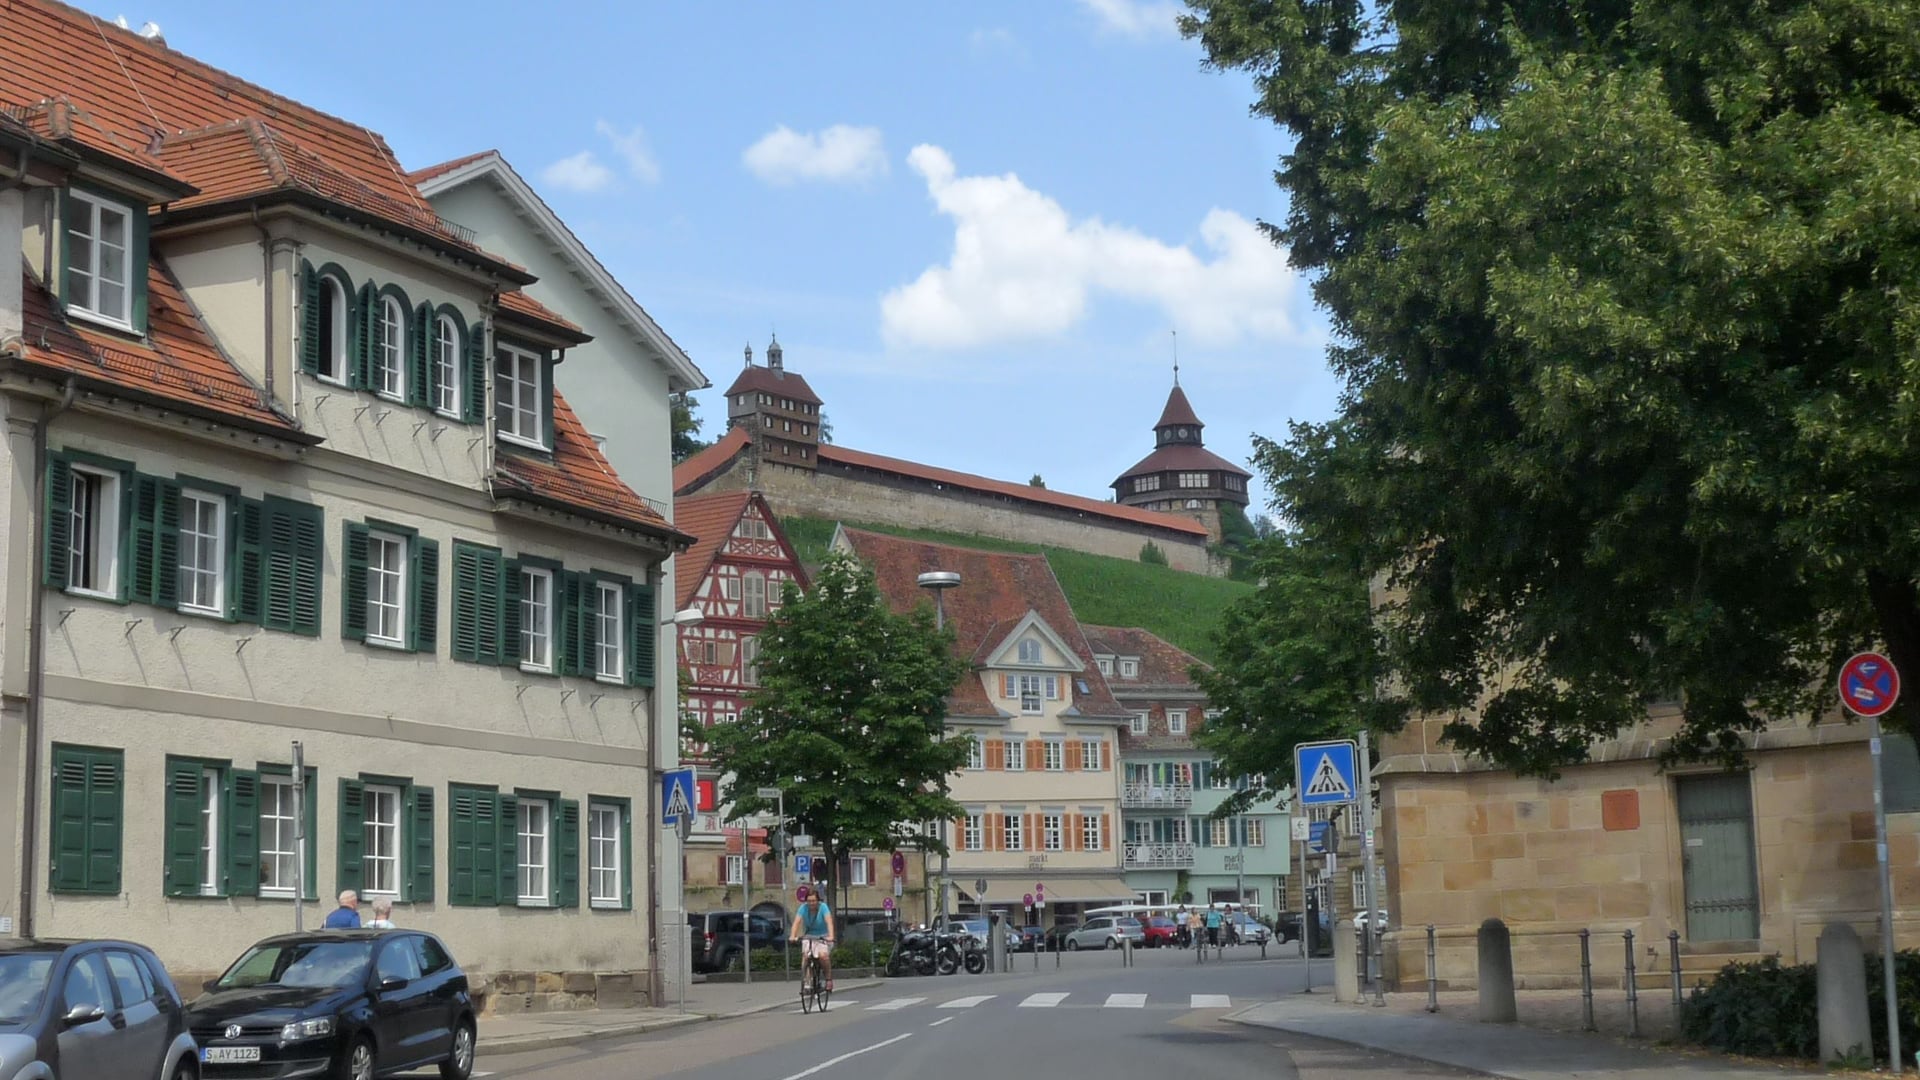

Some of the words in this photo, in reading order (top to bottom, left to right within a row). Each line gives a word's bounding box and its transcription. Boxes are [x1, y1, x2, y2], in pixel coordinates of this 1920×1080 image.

[797, 857, 806, 871] P
[206, 1049, 213, 1060] S
[219, 1049, 232, 1060] AY
[233, 1049, 259, 1060] 1123
